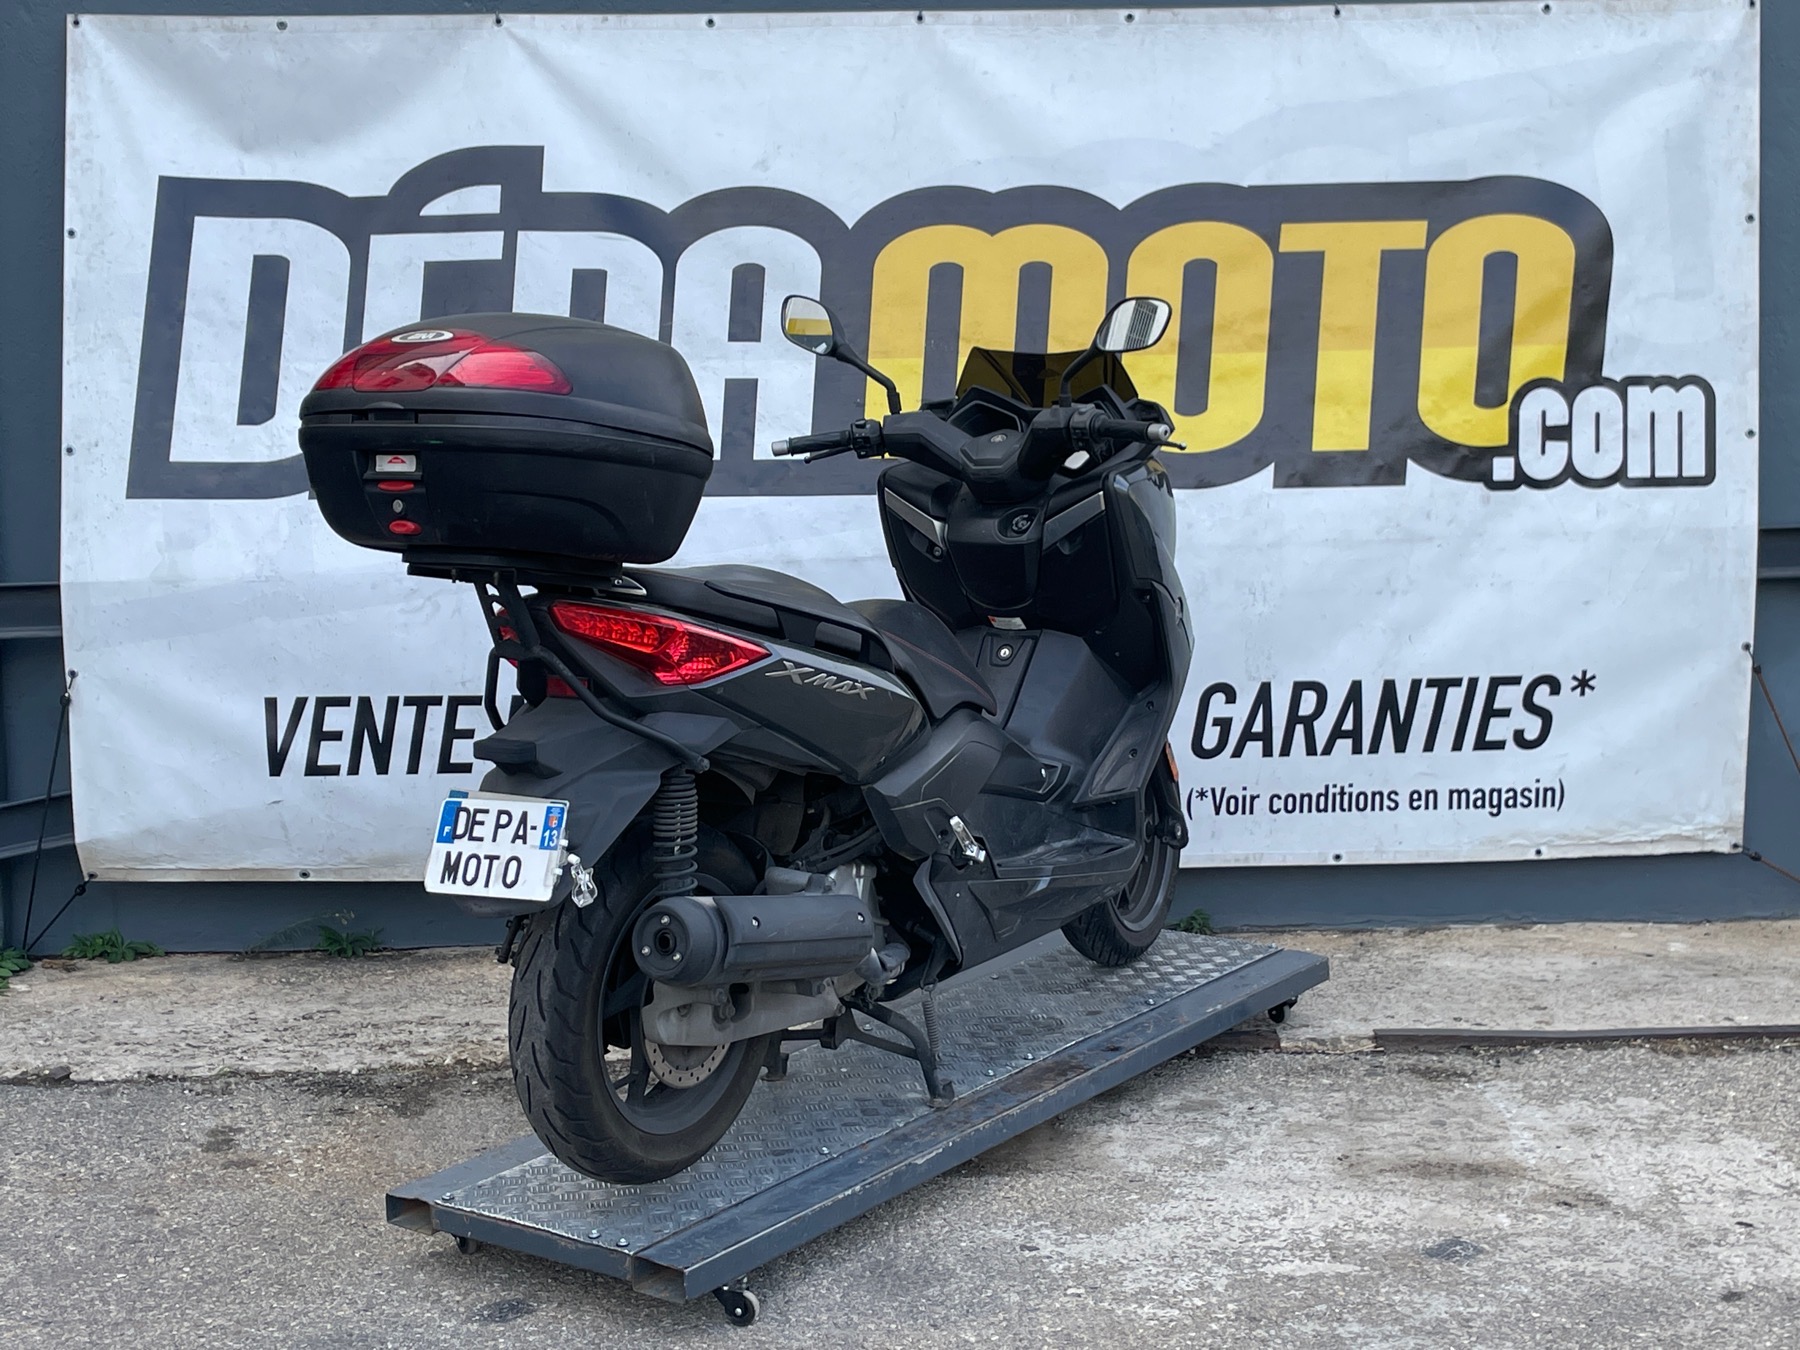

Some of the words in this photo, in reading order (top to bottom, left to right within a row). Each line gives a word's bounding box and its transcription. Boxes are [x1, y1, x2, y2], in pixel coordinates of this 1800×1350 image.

[263, 695, 484, 777] VENTE
[1268, 783, 1400, 815] conditions
[1408, 789, 1439, 811] en
[1447, 778, 1566, 818] magasin)
[442, 825, 452, 837] F
[543, 829, 559, 847] 13
[439, 851, 522, 889] MOTO
